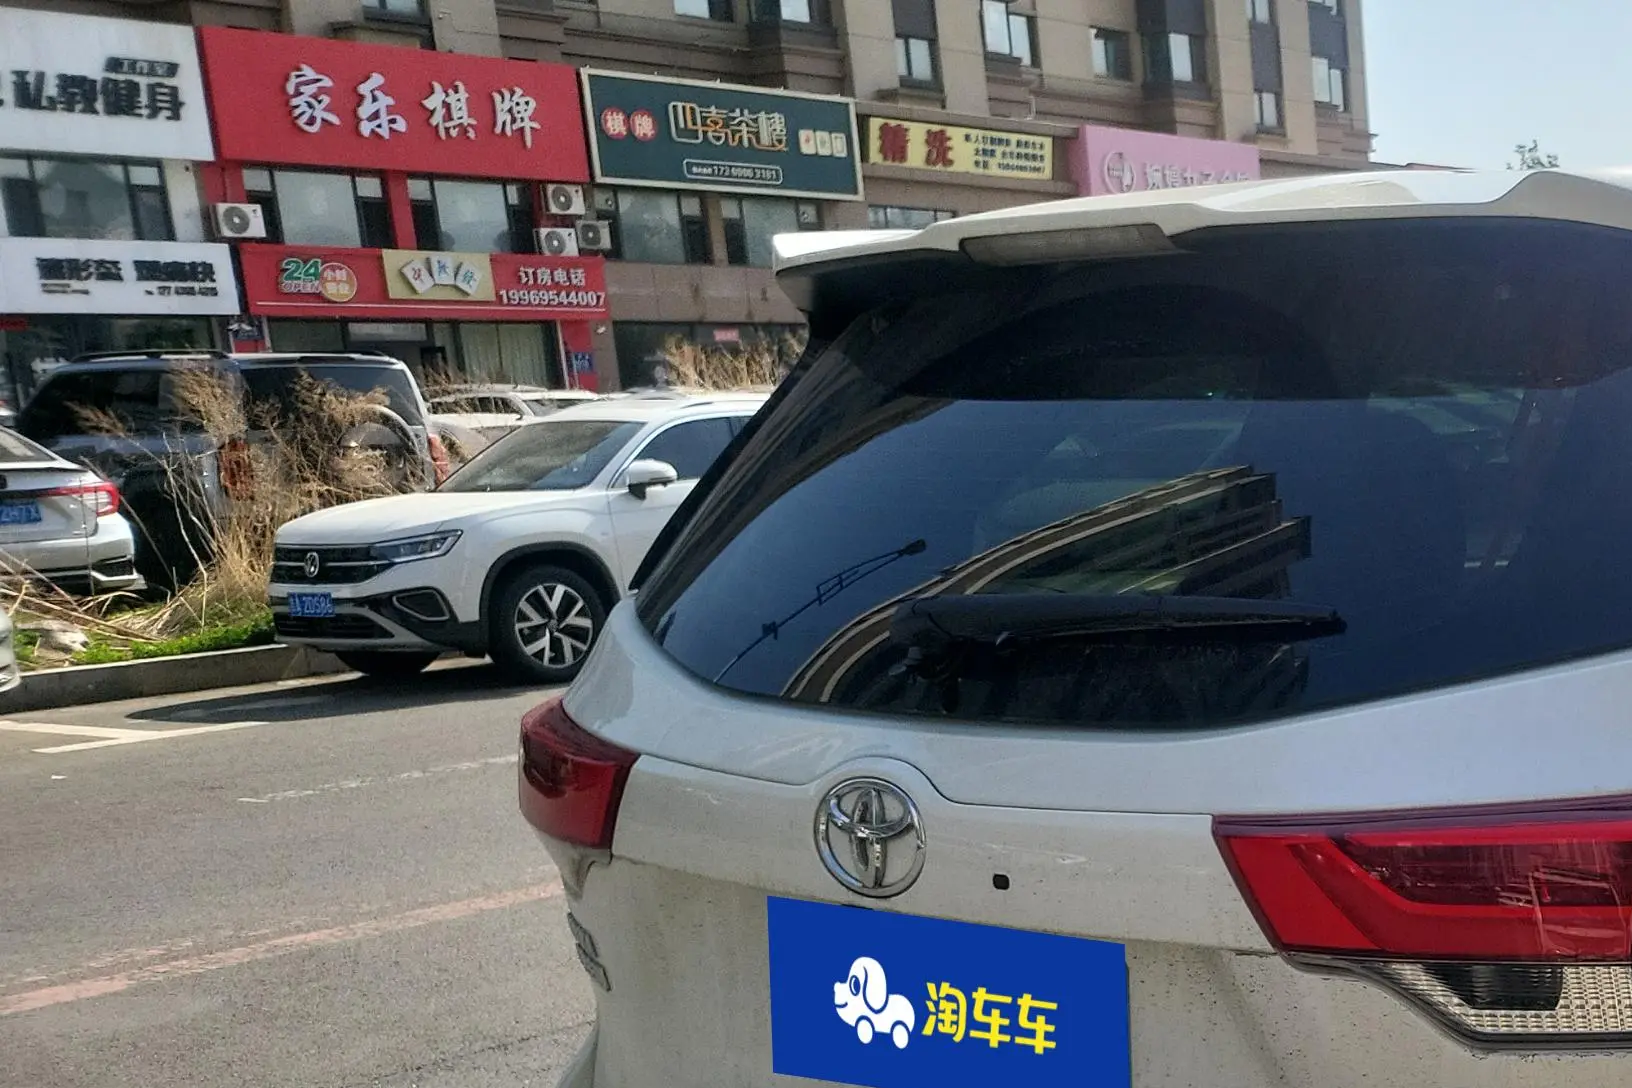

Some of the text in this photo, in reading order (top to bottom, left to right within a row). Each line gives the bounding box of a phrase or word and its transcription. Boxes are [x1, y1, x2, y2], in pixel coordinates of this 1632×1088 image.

[11, 70, 185, 121] 私教健身
[286, 64, 541, 150] 家乐棋牌
[605, 110, 656, 138] 棋牌
[282, 257, 321, 281] 24
[519, 265, 586, 287] 订房电话
[282, 281, 321, 292] OPEN
[500, 289, 605, 307] 19969544007
